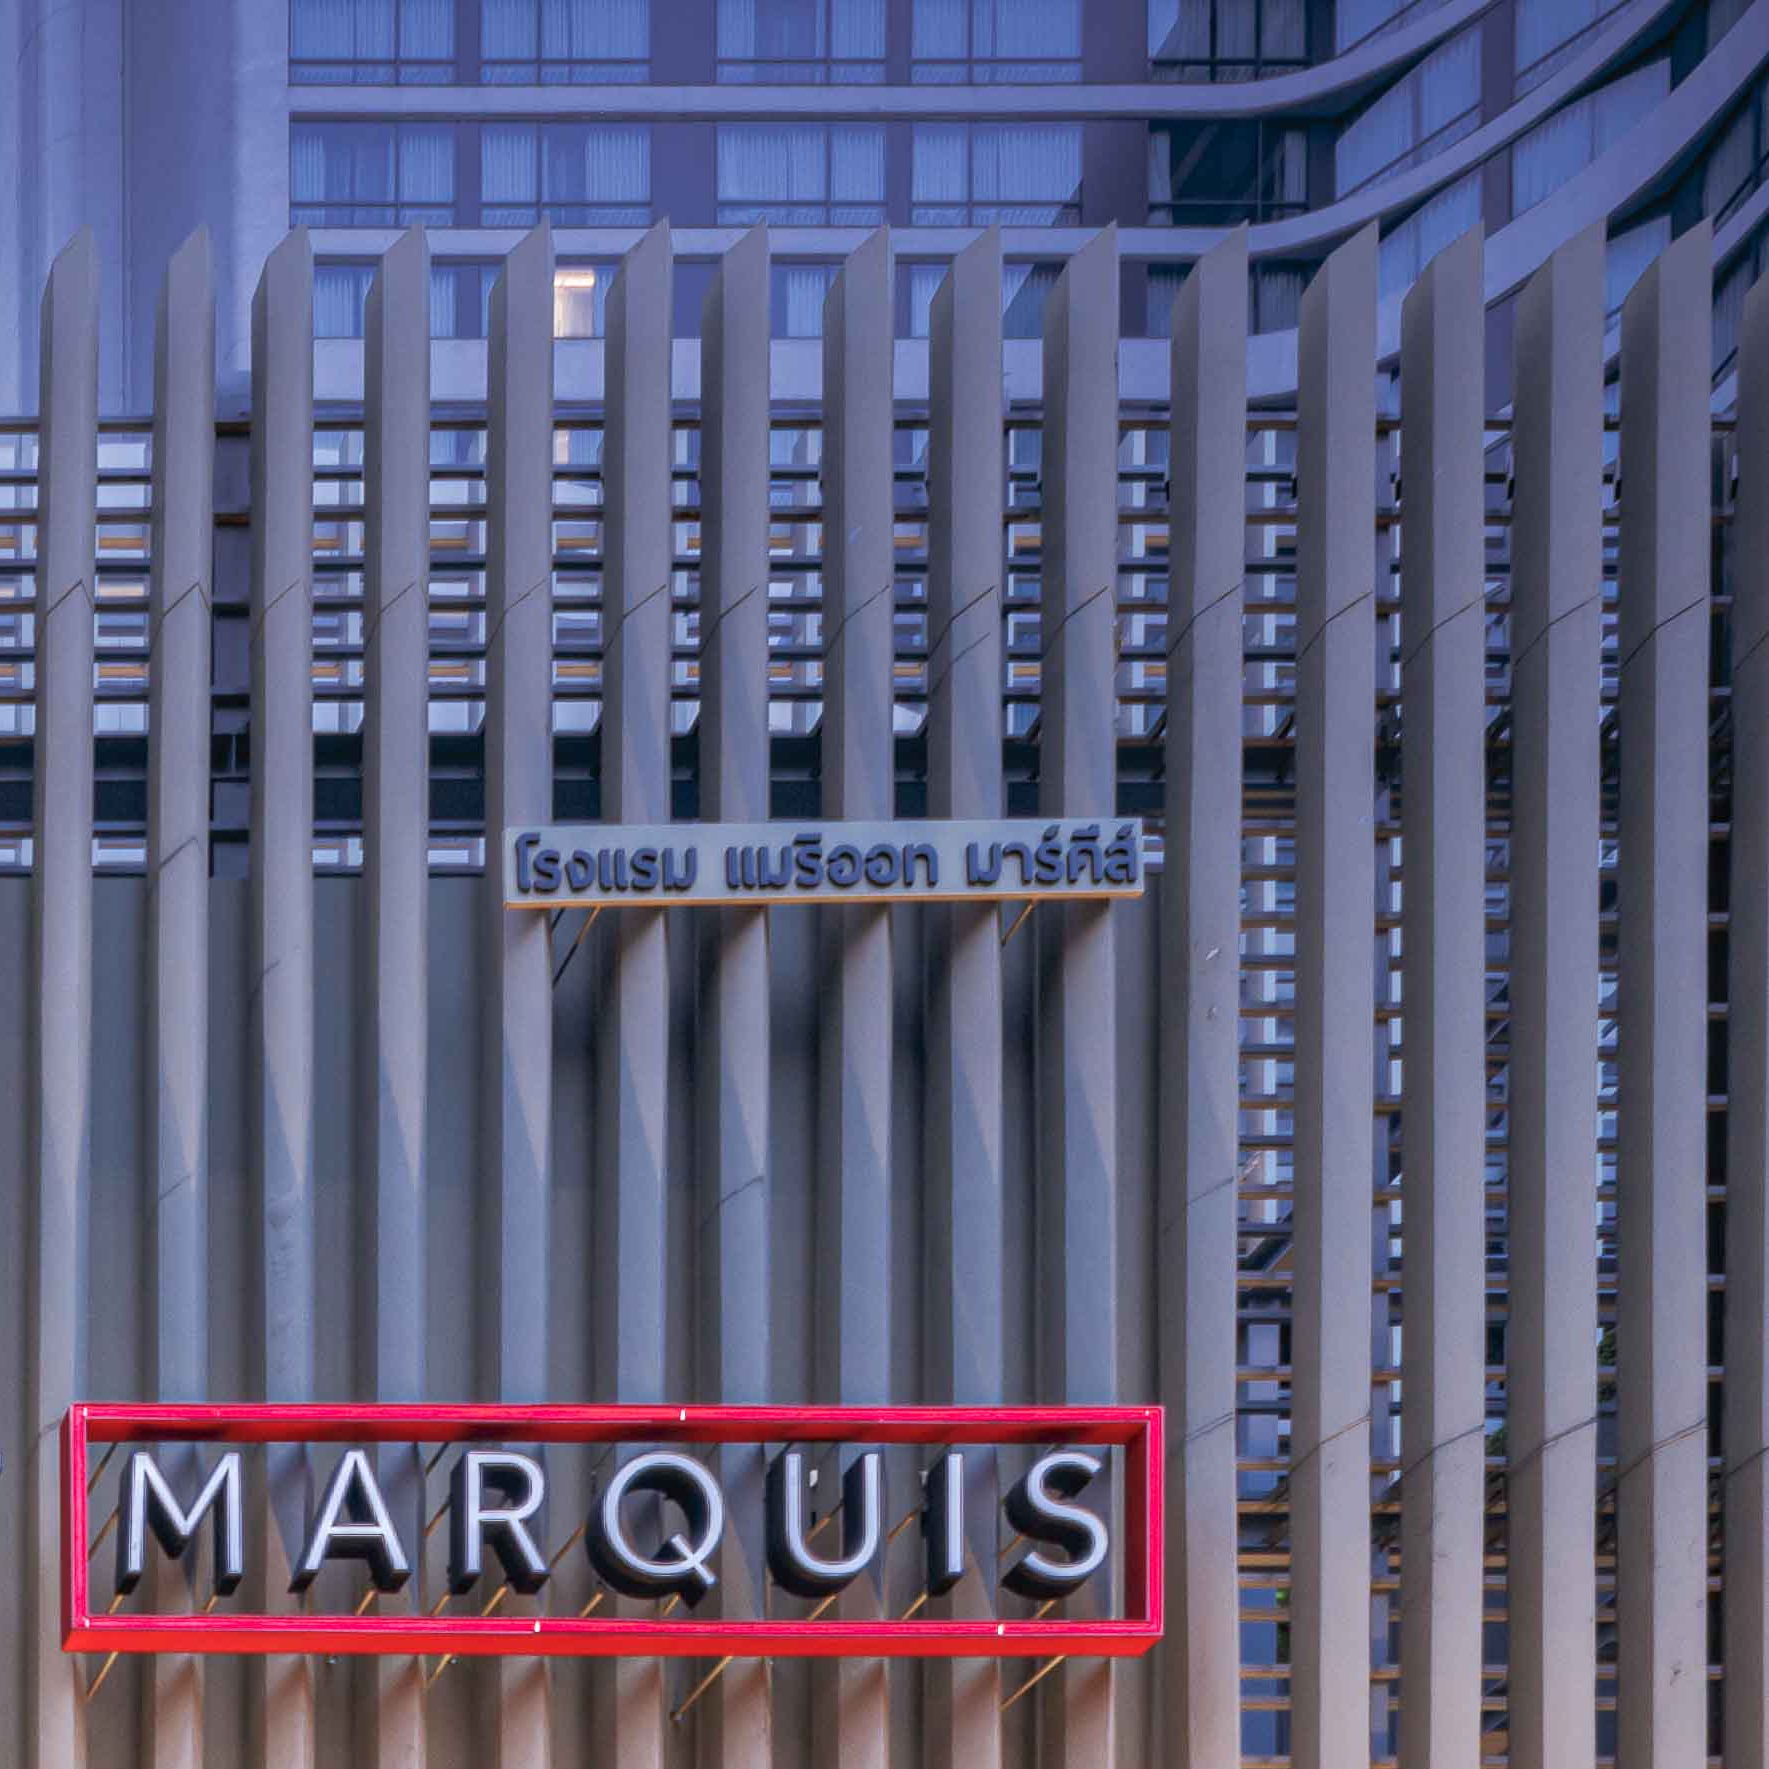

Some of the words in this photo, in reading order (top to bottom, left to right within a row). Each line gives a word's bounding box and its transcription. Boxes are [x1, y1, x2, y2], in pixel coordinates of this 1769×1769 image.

[515, 832, 698, 892] โรงแรม
[724, 832, 939, 889] แมริออท
[965, 824, 1138, 886] มาร์คีส์
[115, 1448, 1110, 1606] MARQUIS
